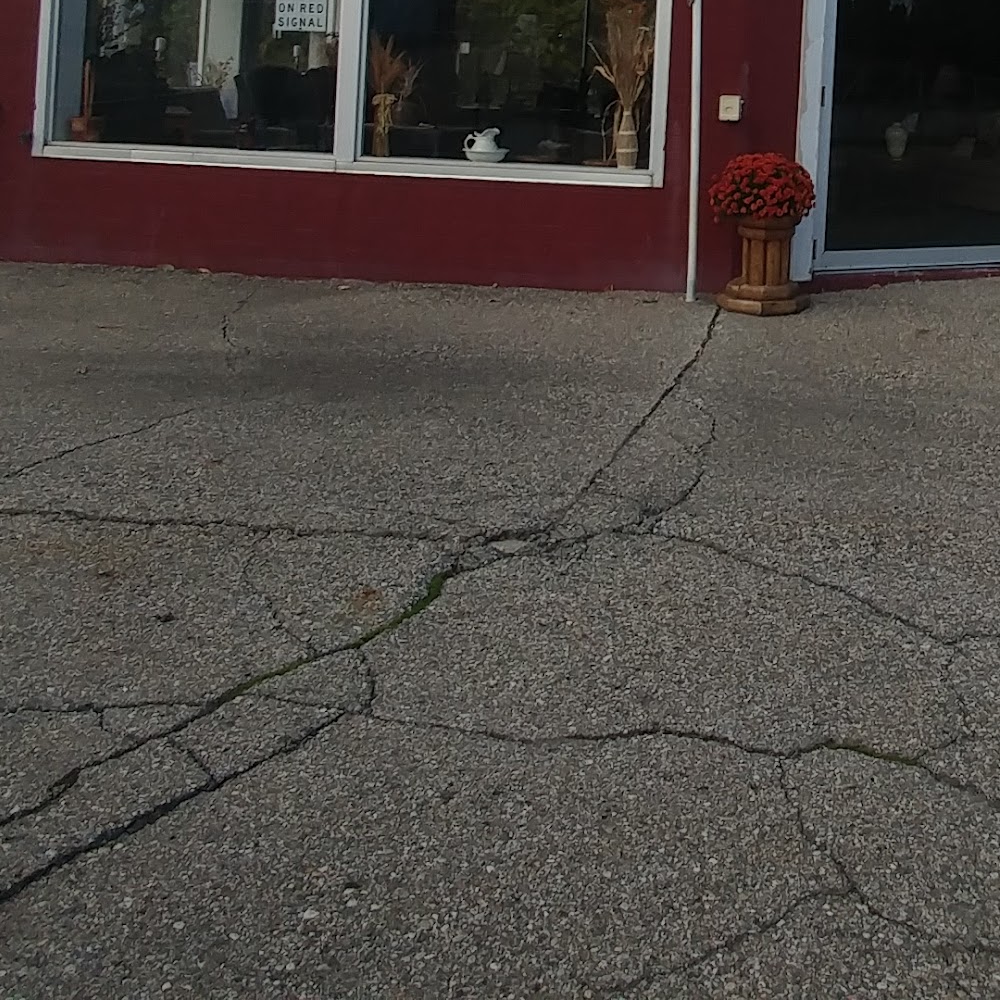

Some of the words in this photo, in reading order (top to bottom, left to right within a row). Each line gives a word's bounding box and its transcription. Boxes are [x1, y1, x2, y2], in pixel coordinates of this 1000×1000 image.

[278, 3, 294, 13] ON
[300, 3, 324, 14] RED
[278, 16, 323, 28] SIGNAL
